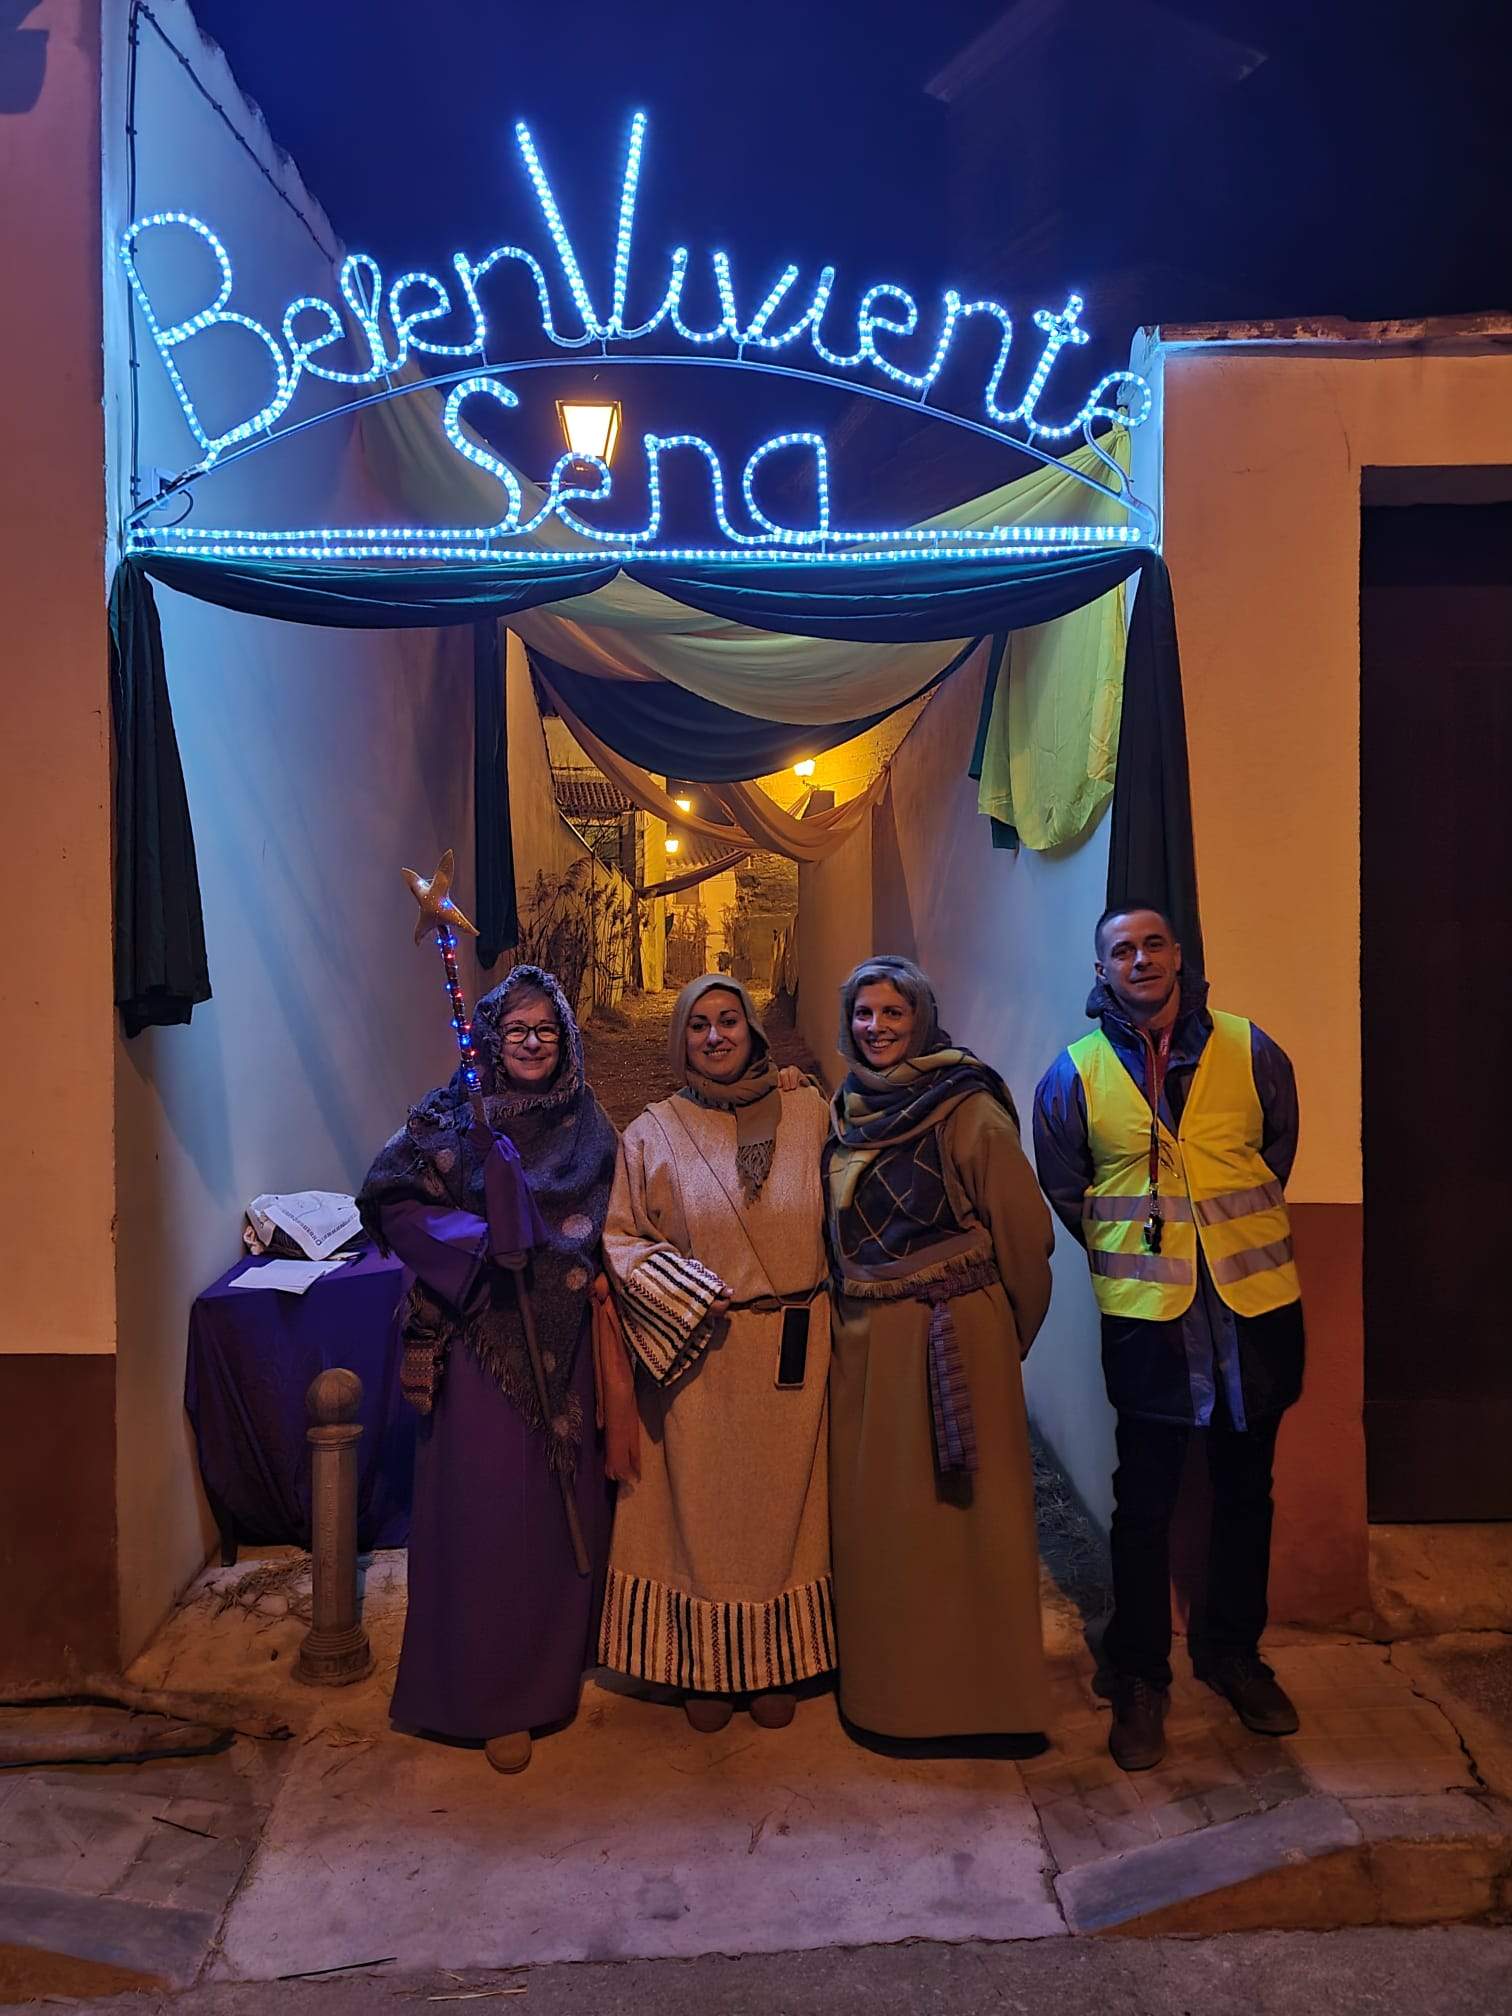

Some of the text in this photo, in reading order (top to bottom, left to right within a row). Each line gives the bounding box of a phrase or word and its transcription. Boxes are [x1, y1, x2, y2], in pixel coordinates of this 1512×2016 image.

[119, 112, 1151, 452] Belen Viviente
[443, 377, 830, 545] Sena
